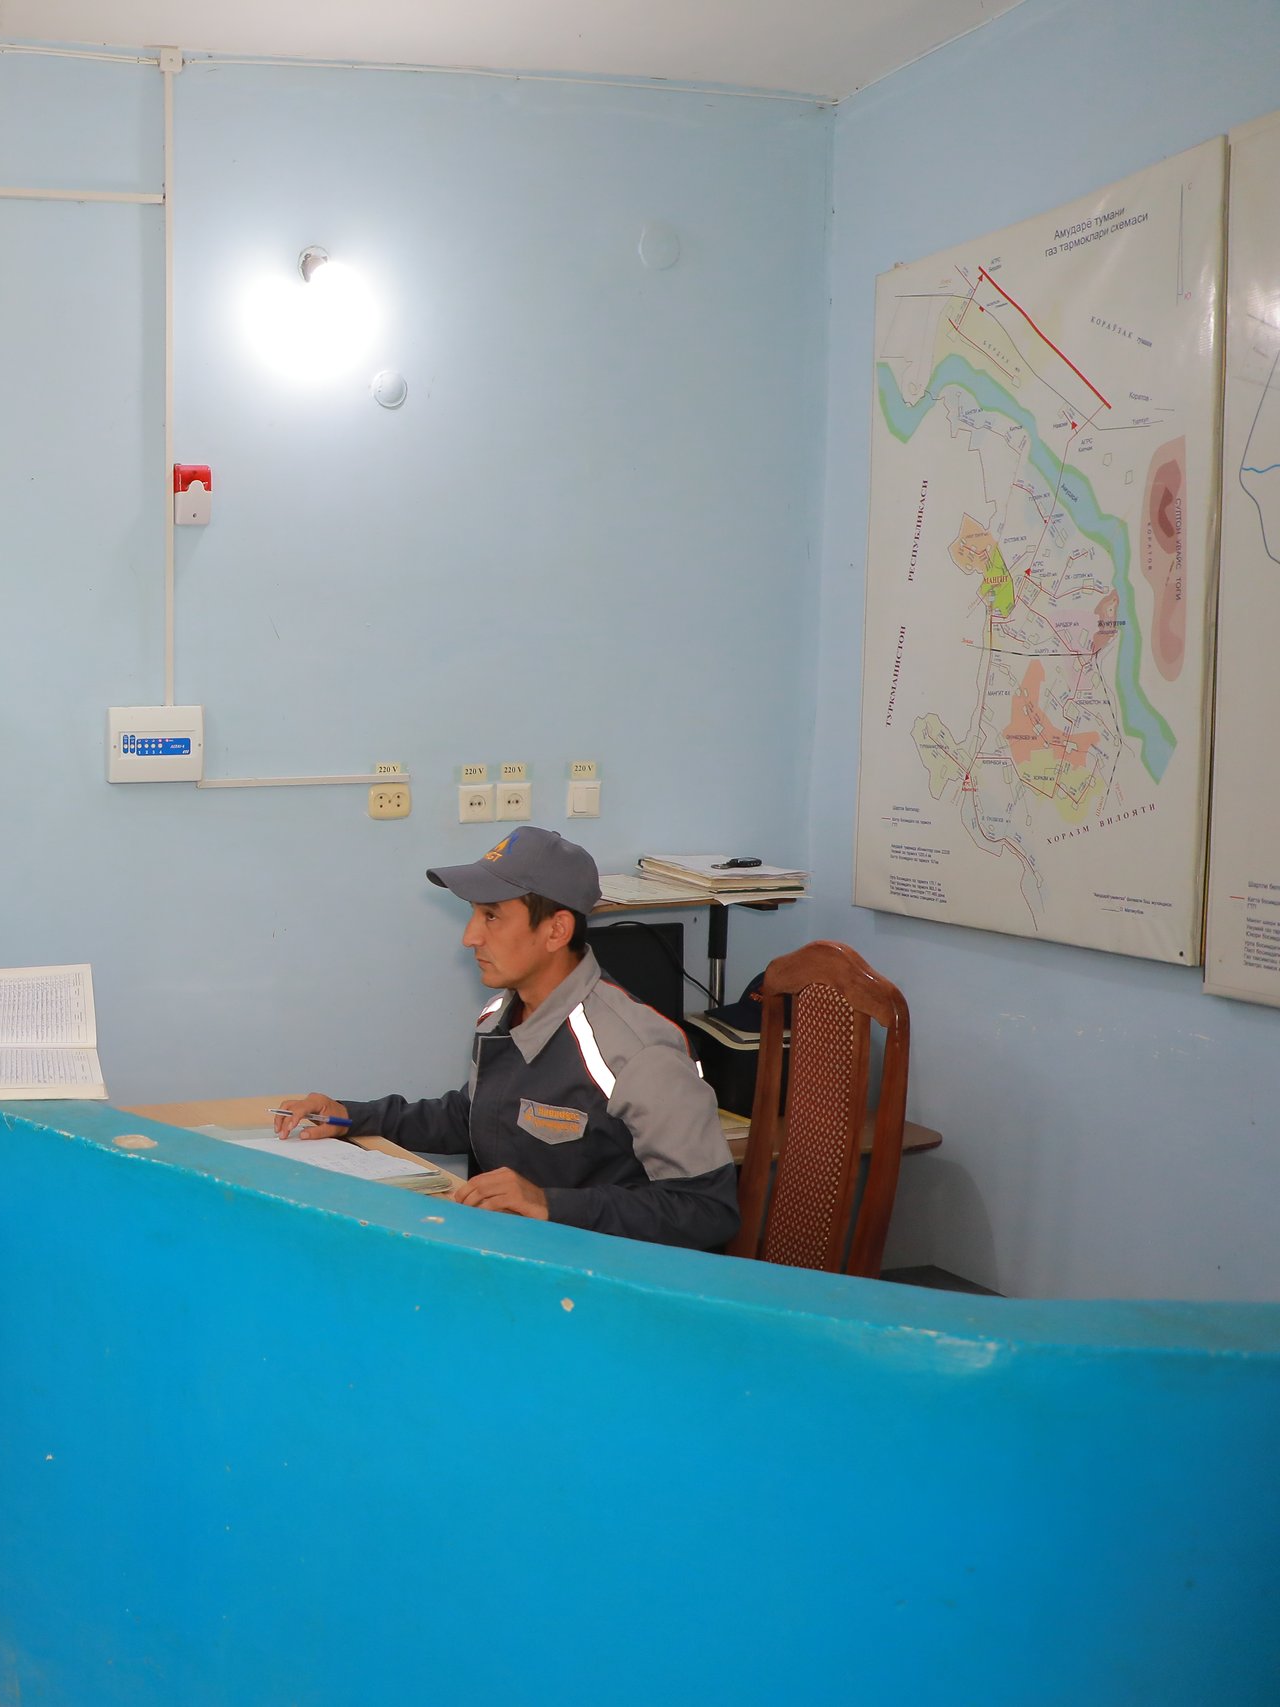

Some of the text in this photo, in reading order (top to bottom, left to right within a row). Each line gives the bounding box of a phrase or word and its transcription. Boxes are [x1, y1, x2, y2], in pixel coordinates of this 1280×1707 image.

[1044, 212, 1148, 256] газ тармоклари схемаси
[1054, 208, 1125, 240] Амударё тумани
[908, 480, 928, 582] РЕСПУБЛИКАСИ
[886, 625, 906, 728] ТУРКМАНИСТОН
[465, 768, 477, 776] 220
[504, 766, 516, 774] 220
[1046, 803, 1156, 846] ХОРАЗМ ВИЛОЯТИ
